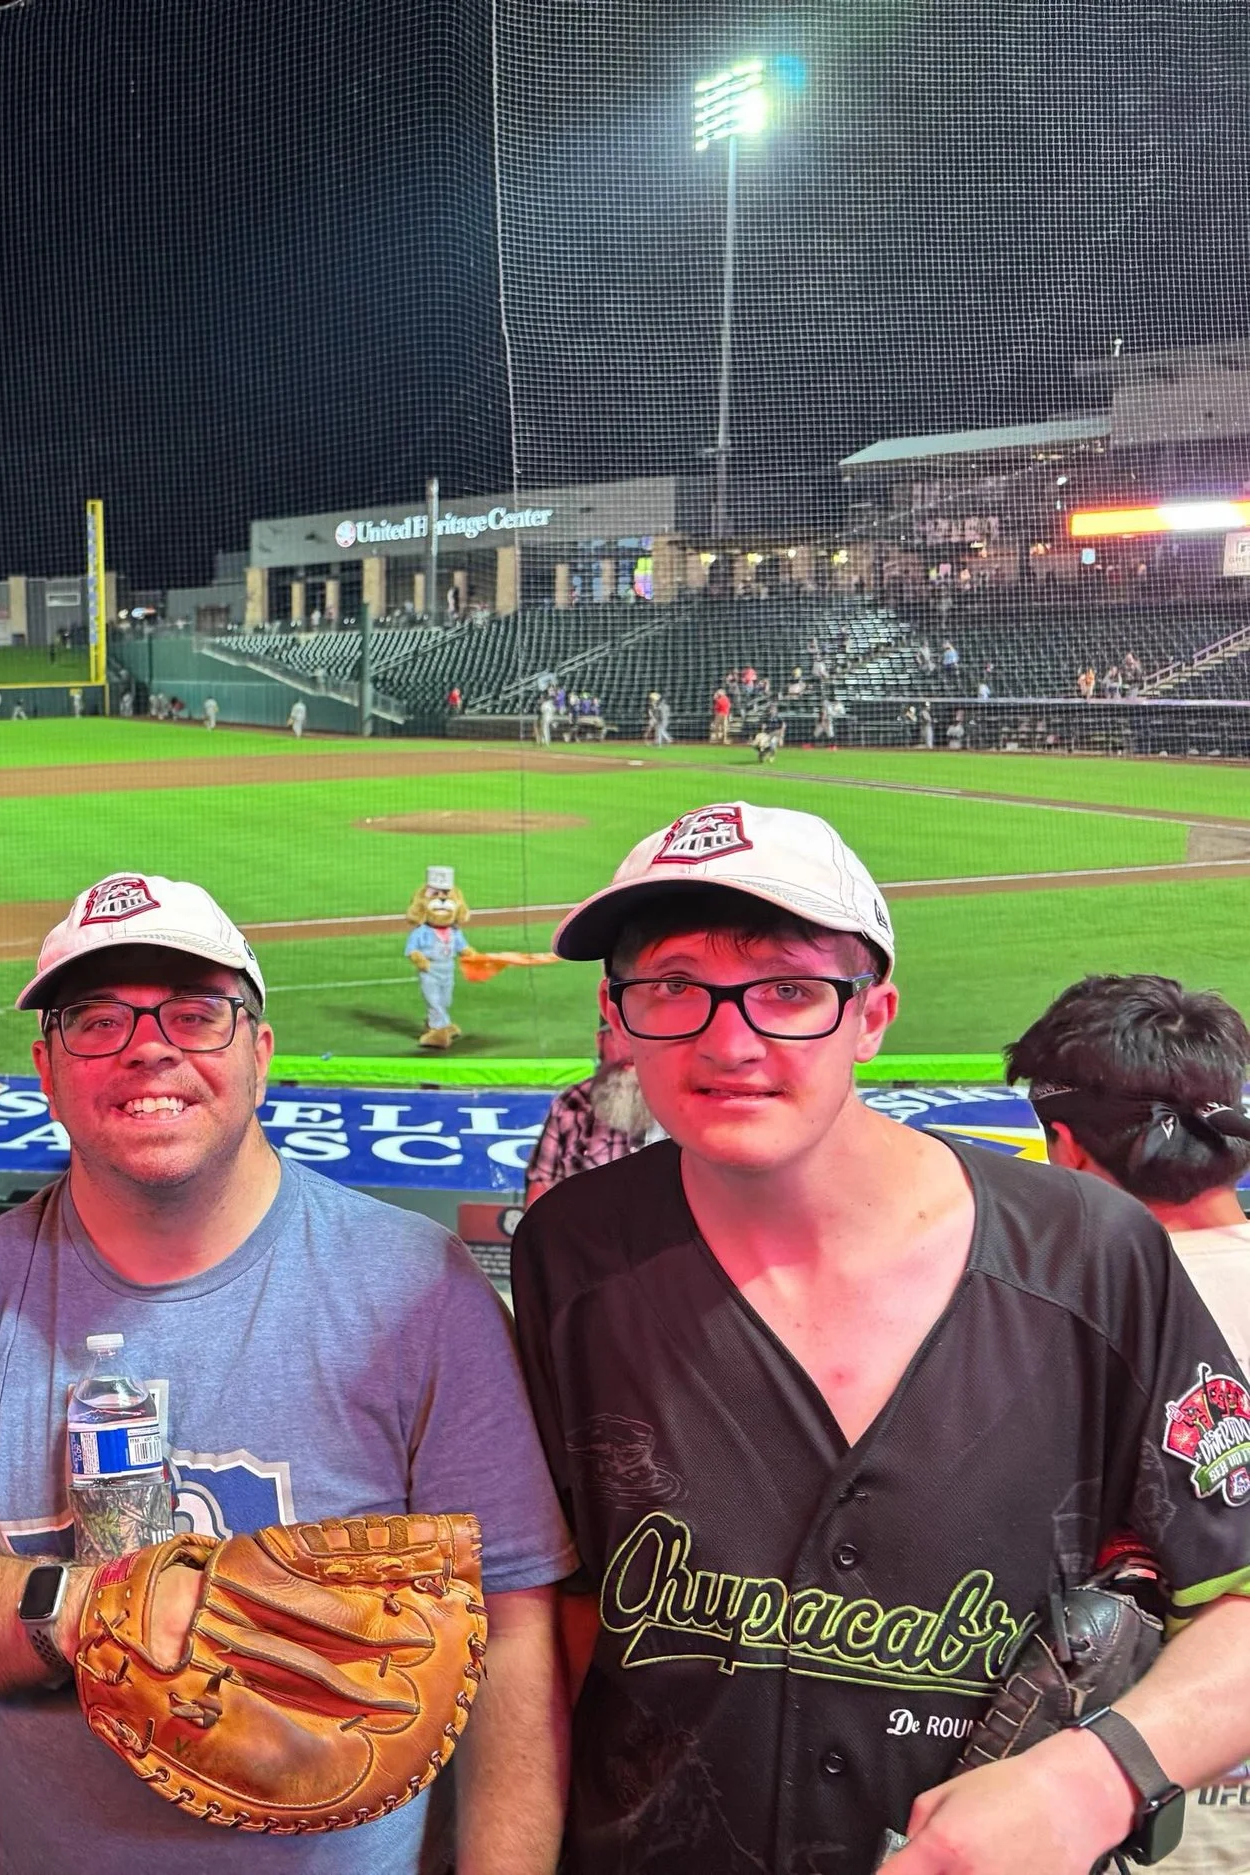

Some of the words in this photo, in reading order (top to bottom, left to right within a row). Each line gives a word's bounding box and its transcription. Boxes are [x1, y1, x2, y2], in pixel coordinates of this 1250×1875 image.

[356, 517, 412, 543] United
[488, 507, 553, 531] Center
[886, 1708, 921, 1736] De
